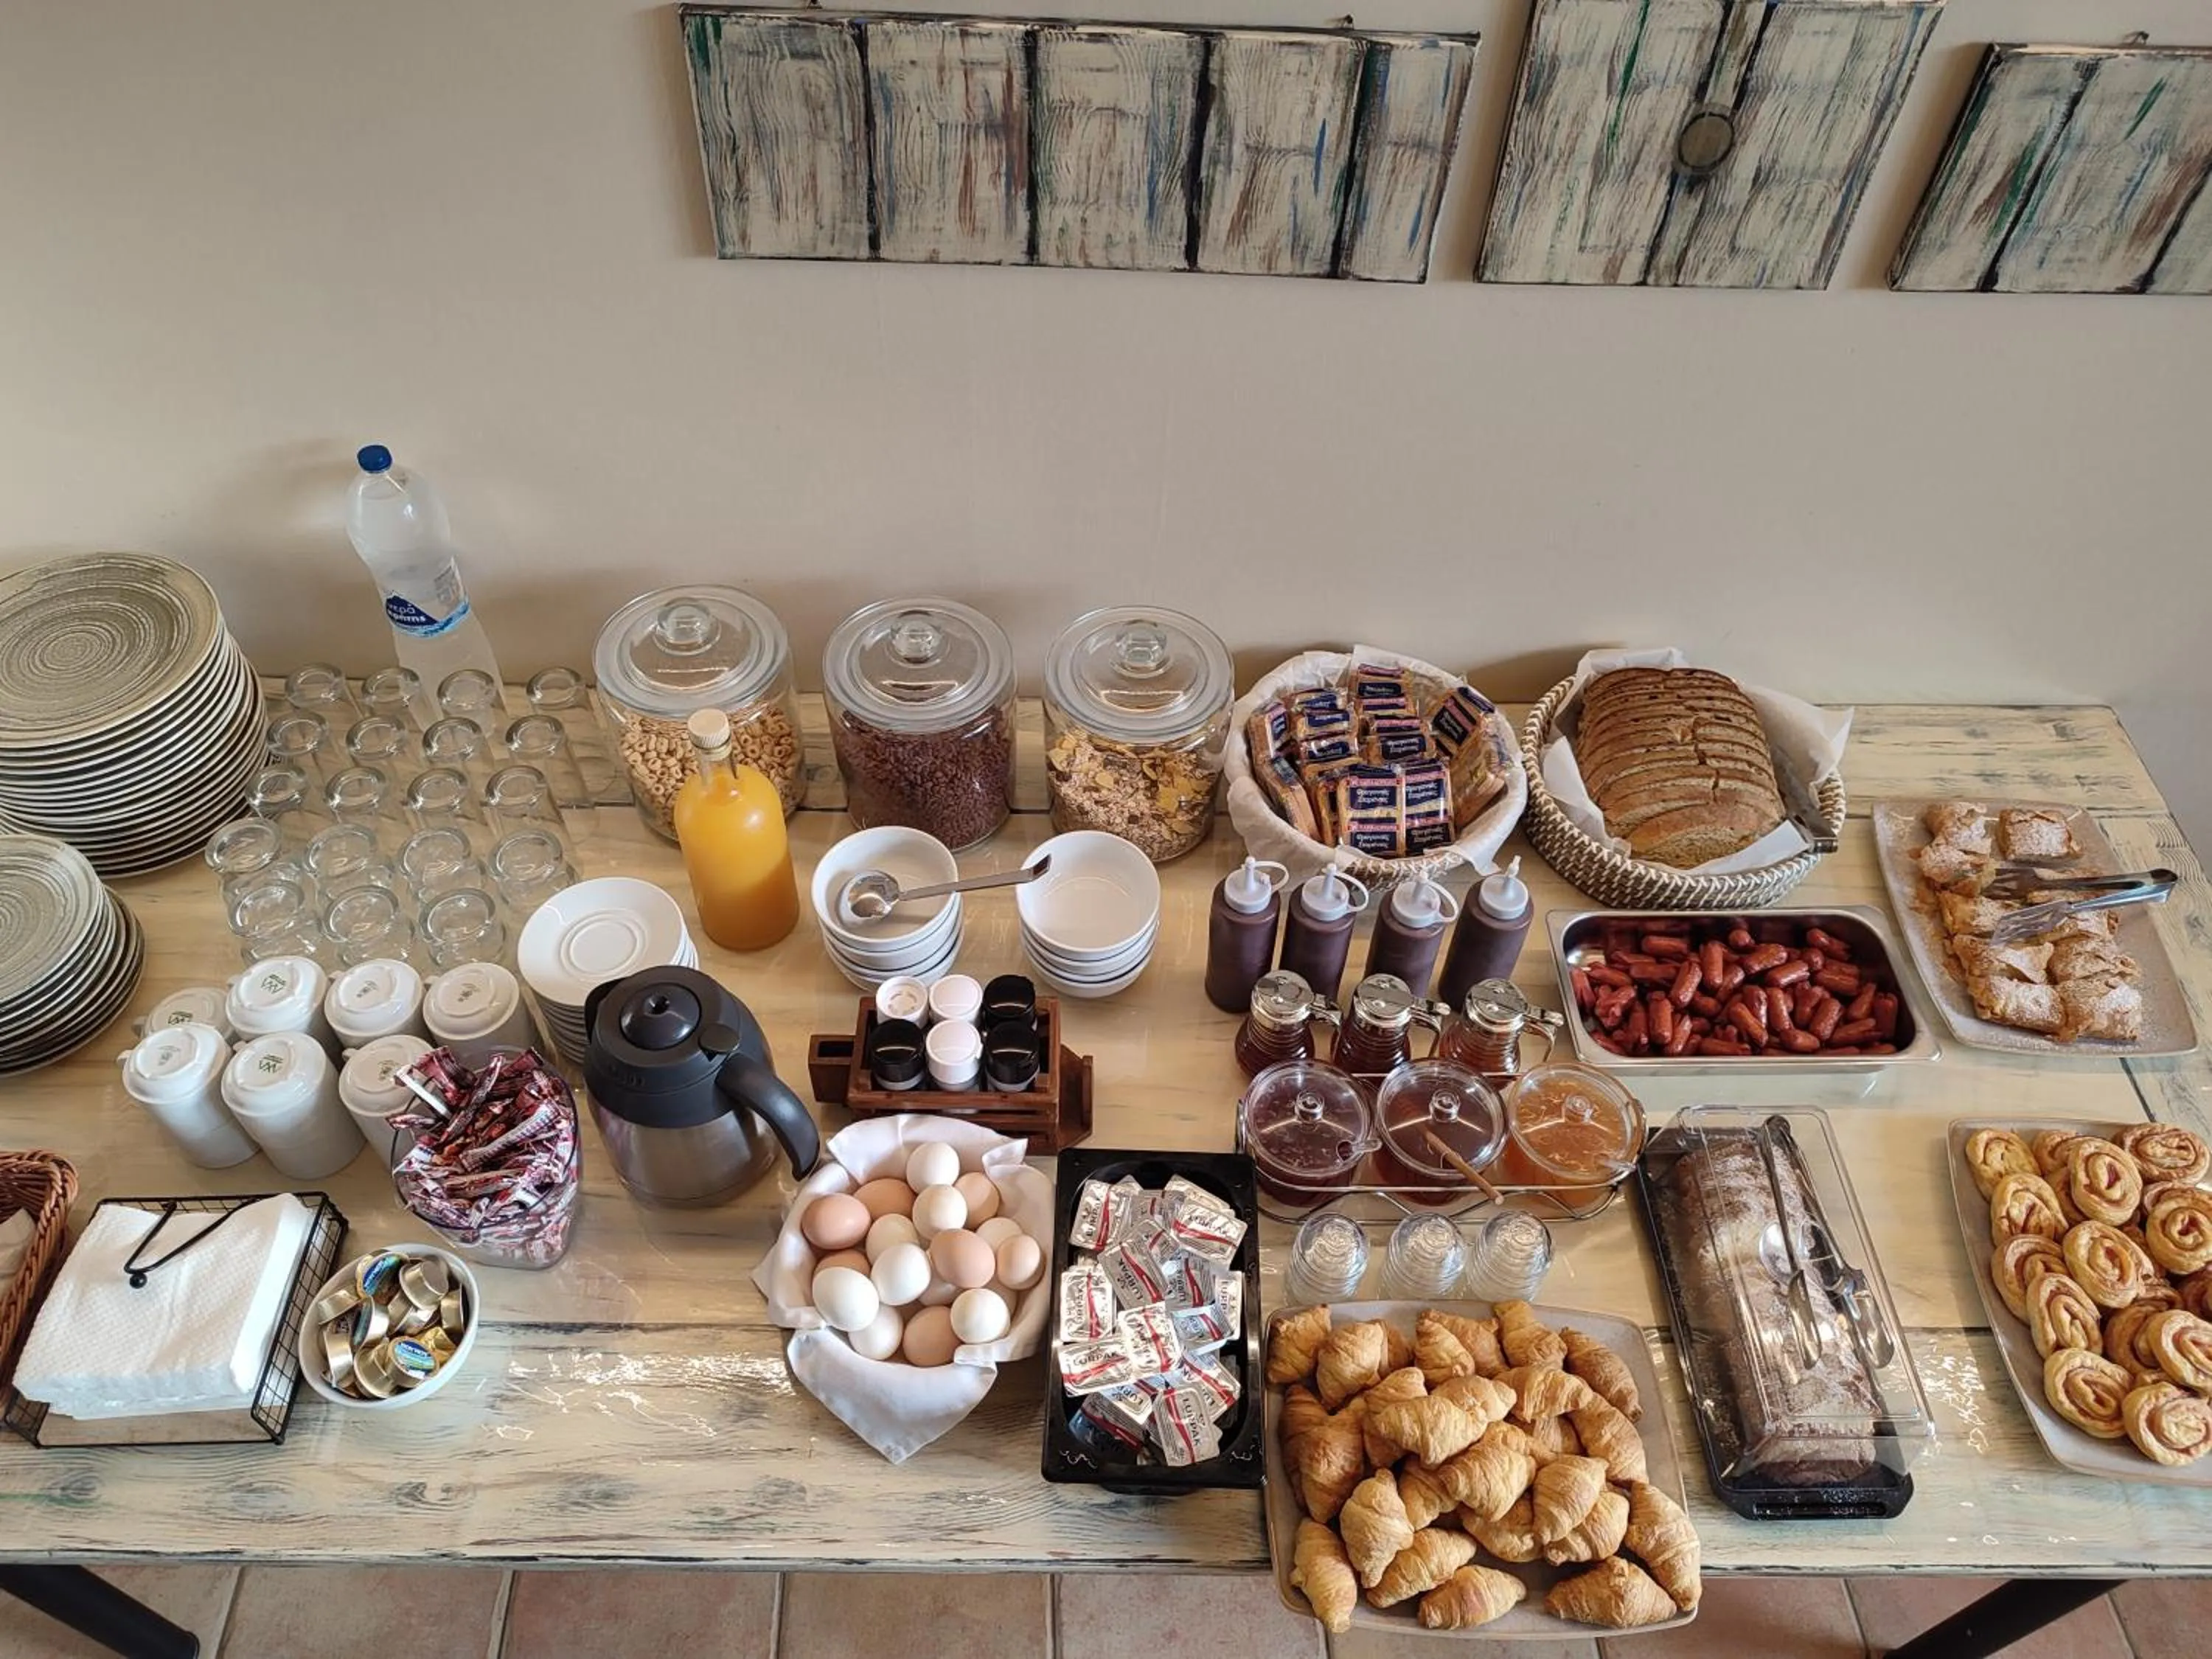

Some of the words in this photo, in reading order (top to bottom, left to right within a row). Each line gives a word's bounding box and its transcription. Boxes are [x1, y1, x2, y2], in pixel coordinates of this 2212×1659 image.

[1118, 1258, 1144, 1301] LURPAK
[1220, 1280, 1229, 1310] LURP
[1117, 1384, 1144, 1406] LURP
[1182, 1397, 1200, 1447] LURPAK
